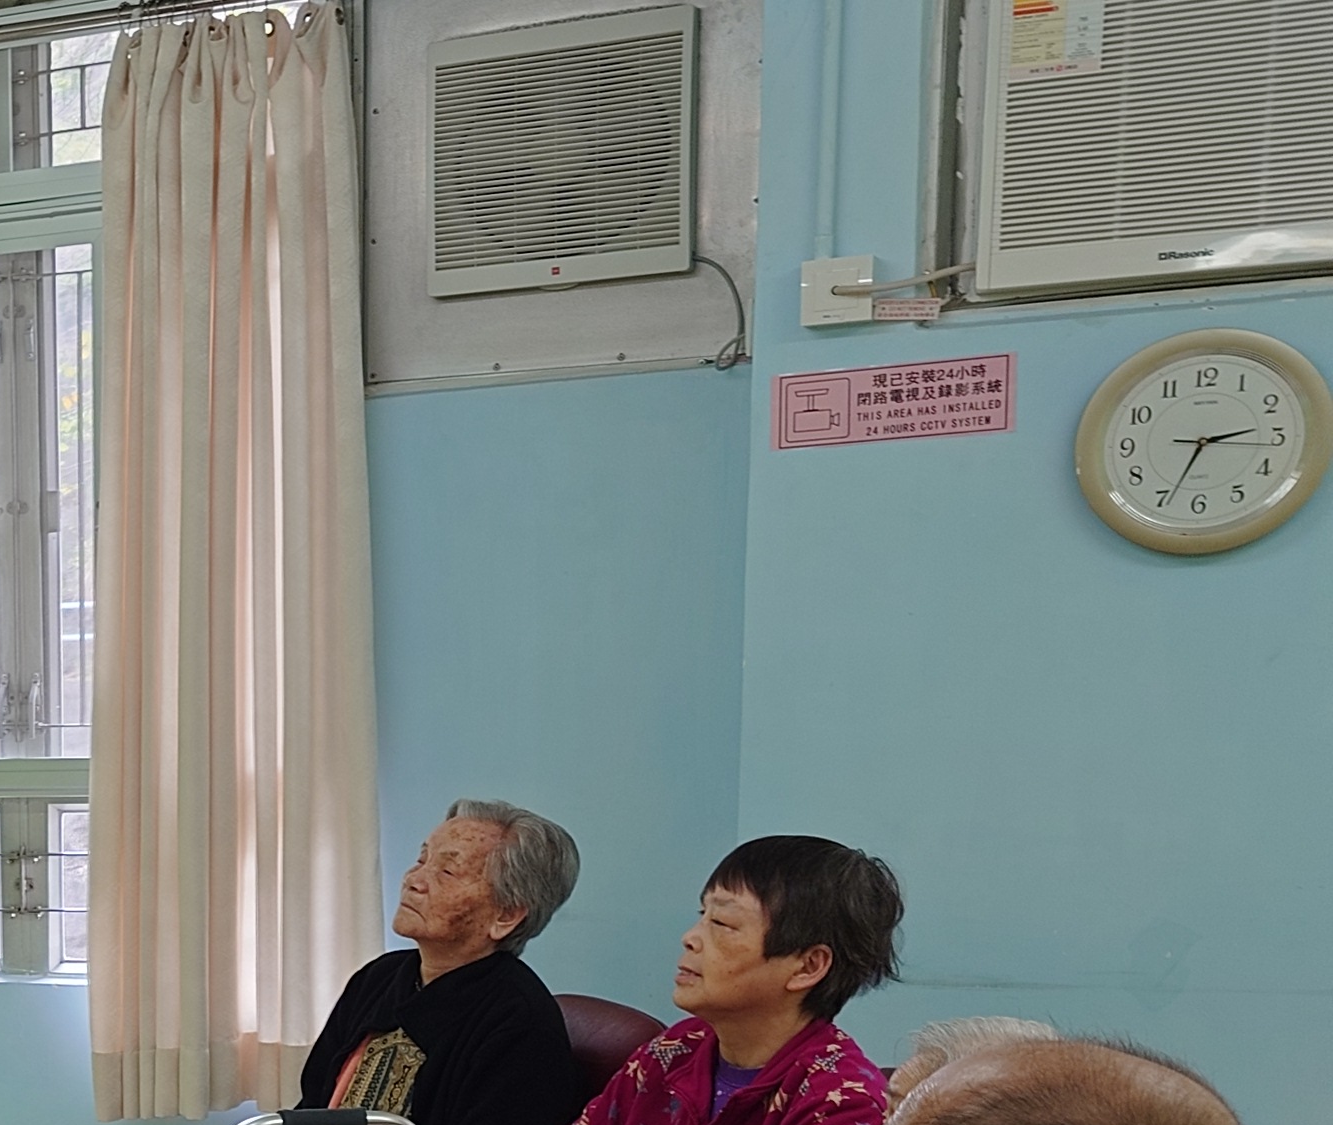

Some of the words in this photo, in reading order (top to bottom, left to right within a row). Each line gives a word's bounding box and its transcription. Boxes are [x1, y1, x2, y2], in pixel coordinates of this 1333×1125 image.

[1168, 247, 1214, 260] Rasonic
[1194, 367, 1219, 388] 12
[1237, 373, 1247, 392] 1
[1161, 380, 1178, 399] 11
[857, 411, 883, 422] THIS
[886, 408, 913, 419] AREA
[917, 405, 938, 416] HAS
[942, 399, 1002, 414] INSTALLED
[1263, 394, 1279, 414] 2
[1129, 406, 1152, 425] 10
[866, 426, 879, 437] 24
[883, 422, 916, 434] HOURS
[920, 419, 947, 431] CCTV
[951, 415, 992, 428] SYSTEM
[1271, 427, 1286, 447] 3
[1119, 438, 1136, 458] 9
[1128, 466, 1144, 486] 8
[1254, 458, 1273, 476] 4
[1155, 490, 1170, 508] 7
[1191, 494, 1208, 514] 6
[1229, 485, 1245, 503] 5
